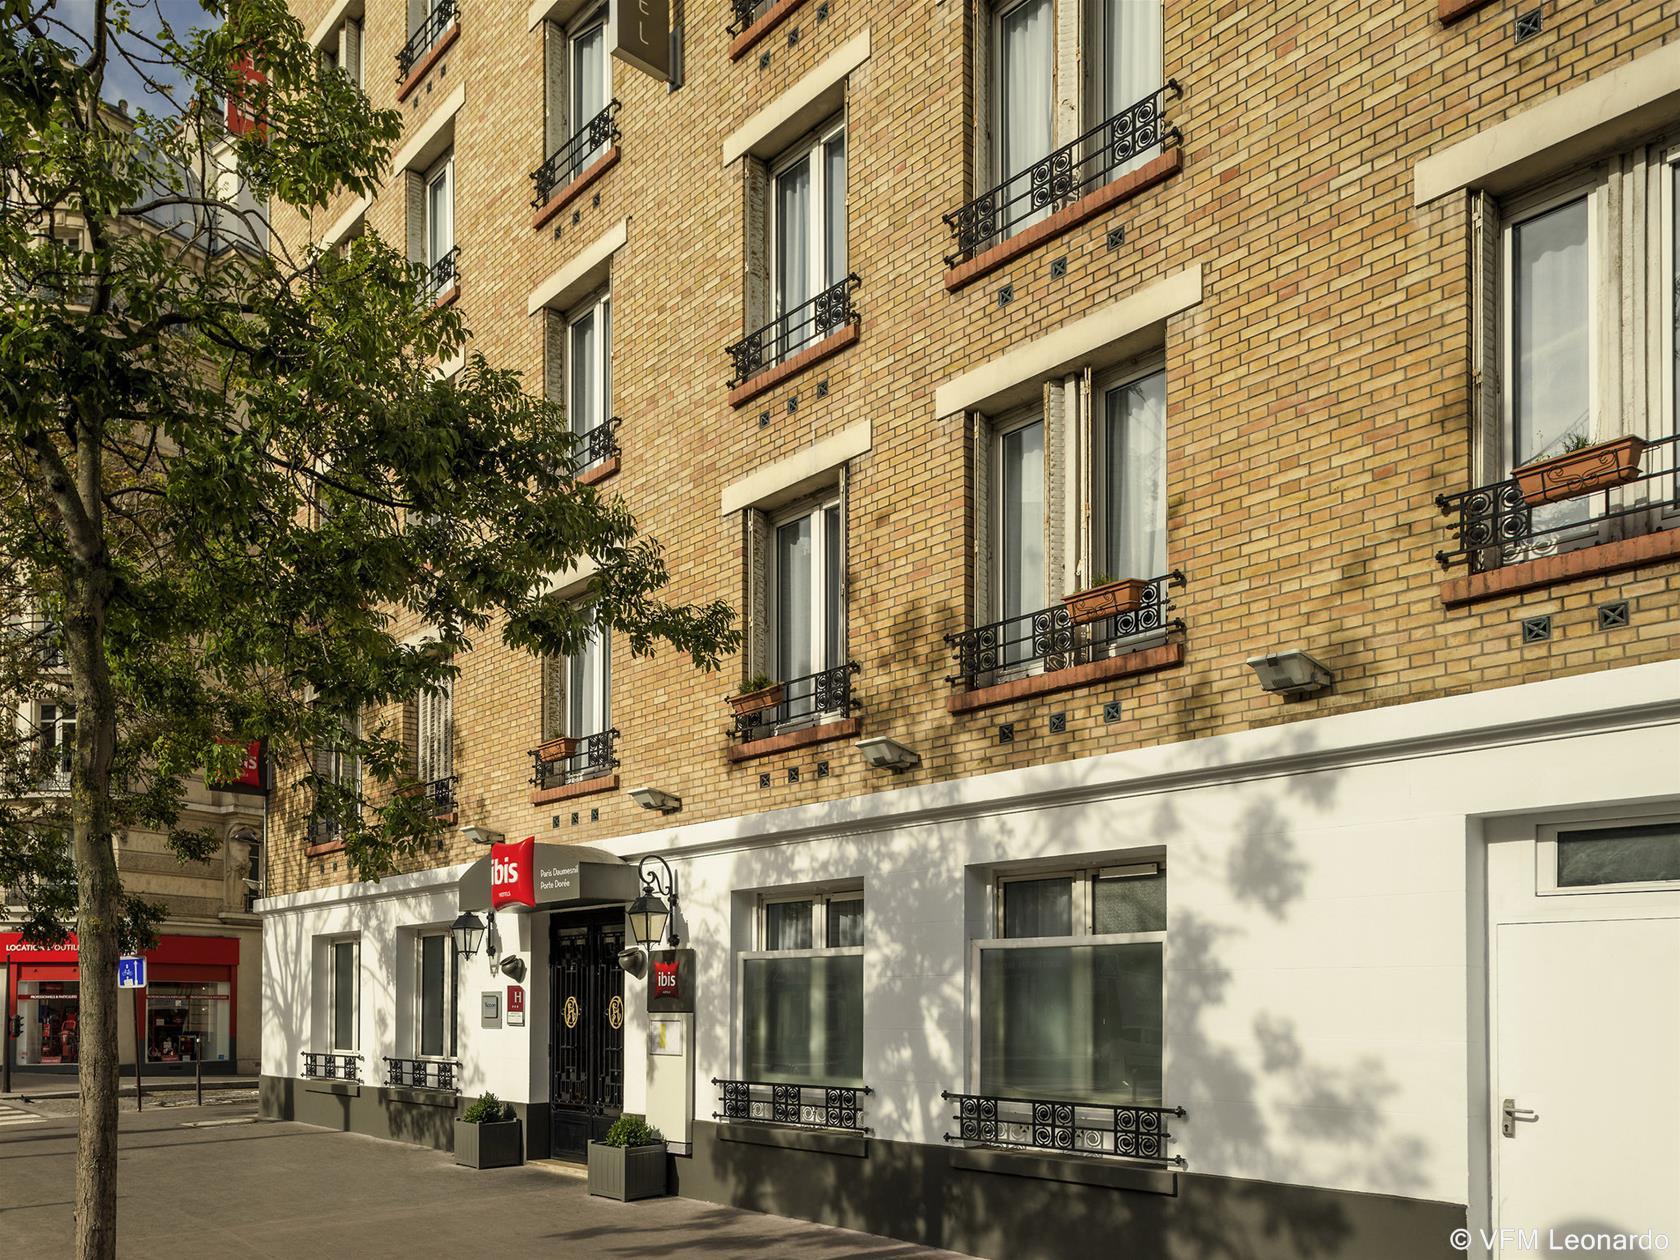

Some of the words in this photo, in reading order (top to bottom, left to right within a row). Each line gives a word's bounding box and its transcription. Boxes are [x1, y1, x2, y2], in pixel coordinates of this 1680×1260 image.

[491, 856, 519, 886] ibis
[540, 869, 553, 878] Paris
[540, 881, 554, 890] Porte
[554, 878, 570, 888] Dorée
[658, 971, 676, 987] ibis
[514, 991, 522, 1003] H
